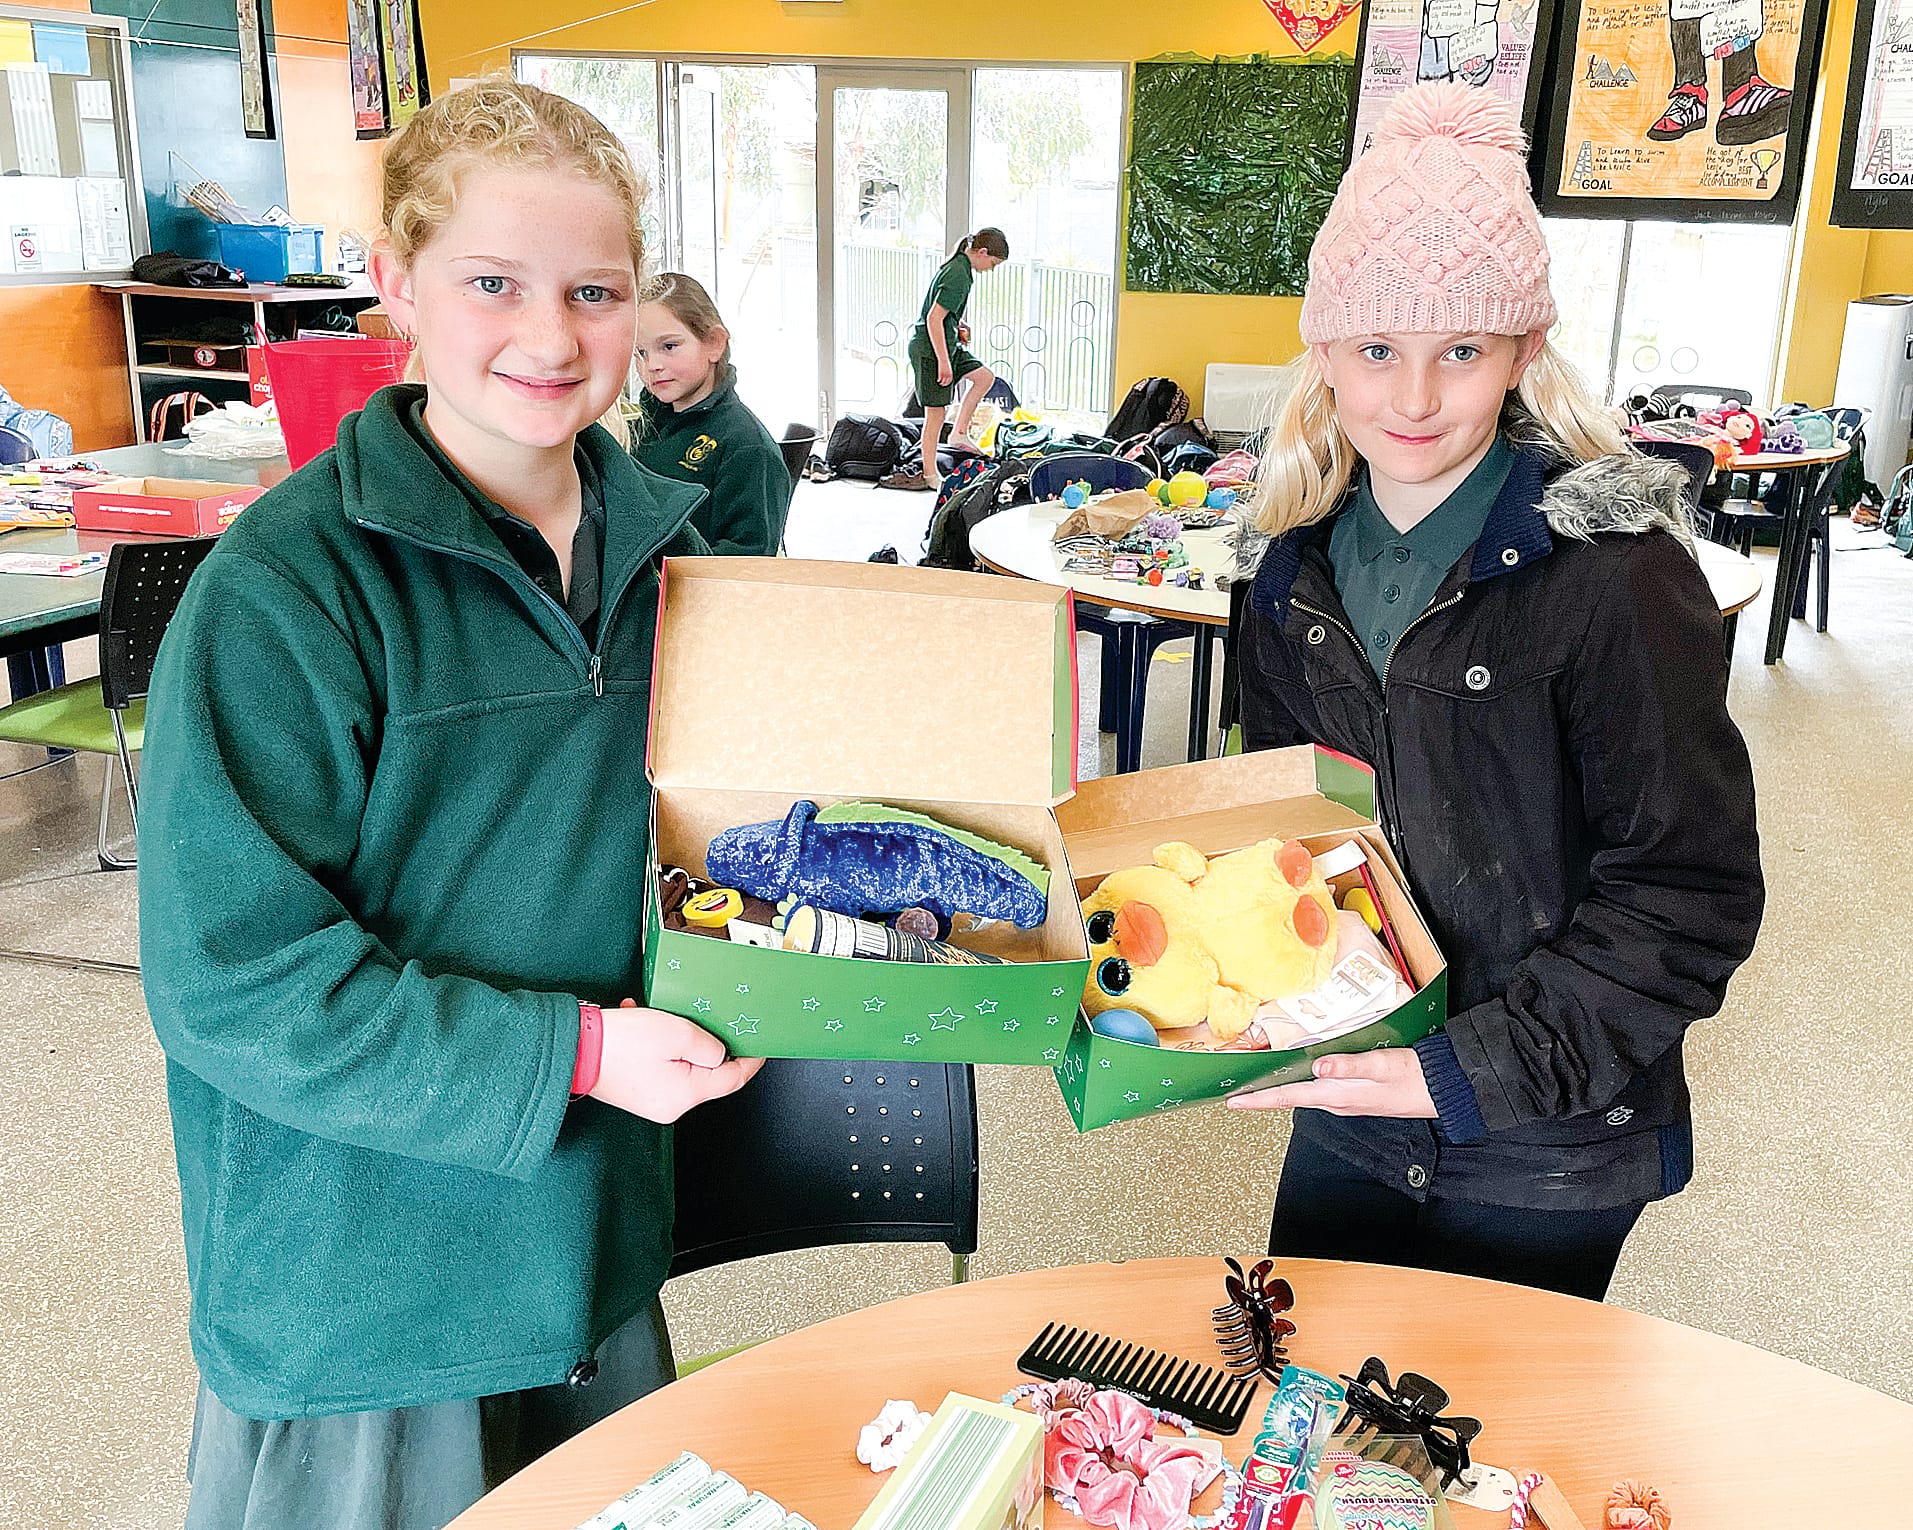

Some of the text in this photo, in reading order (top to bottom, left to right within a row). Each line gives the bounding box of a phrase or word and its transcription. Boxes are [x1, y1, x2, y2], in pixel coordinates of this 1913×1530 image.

[1374, 67, 1402, 76] CHALLENGE
[1589, 78, 1629, 88] CHALLENGE
[1738, 165, 1754, 175] BEST
[1581, 179, 1613, 191] GOAL
[687, 1487, 717, 1510] NATURAL
[1341, 1496, 1438, 1506] DETANGLING BRUSH
